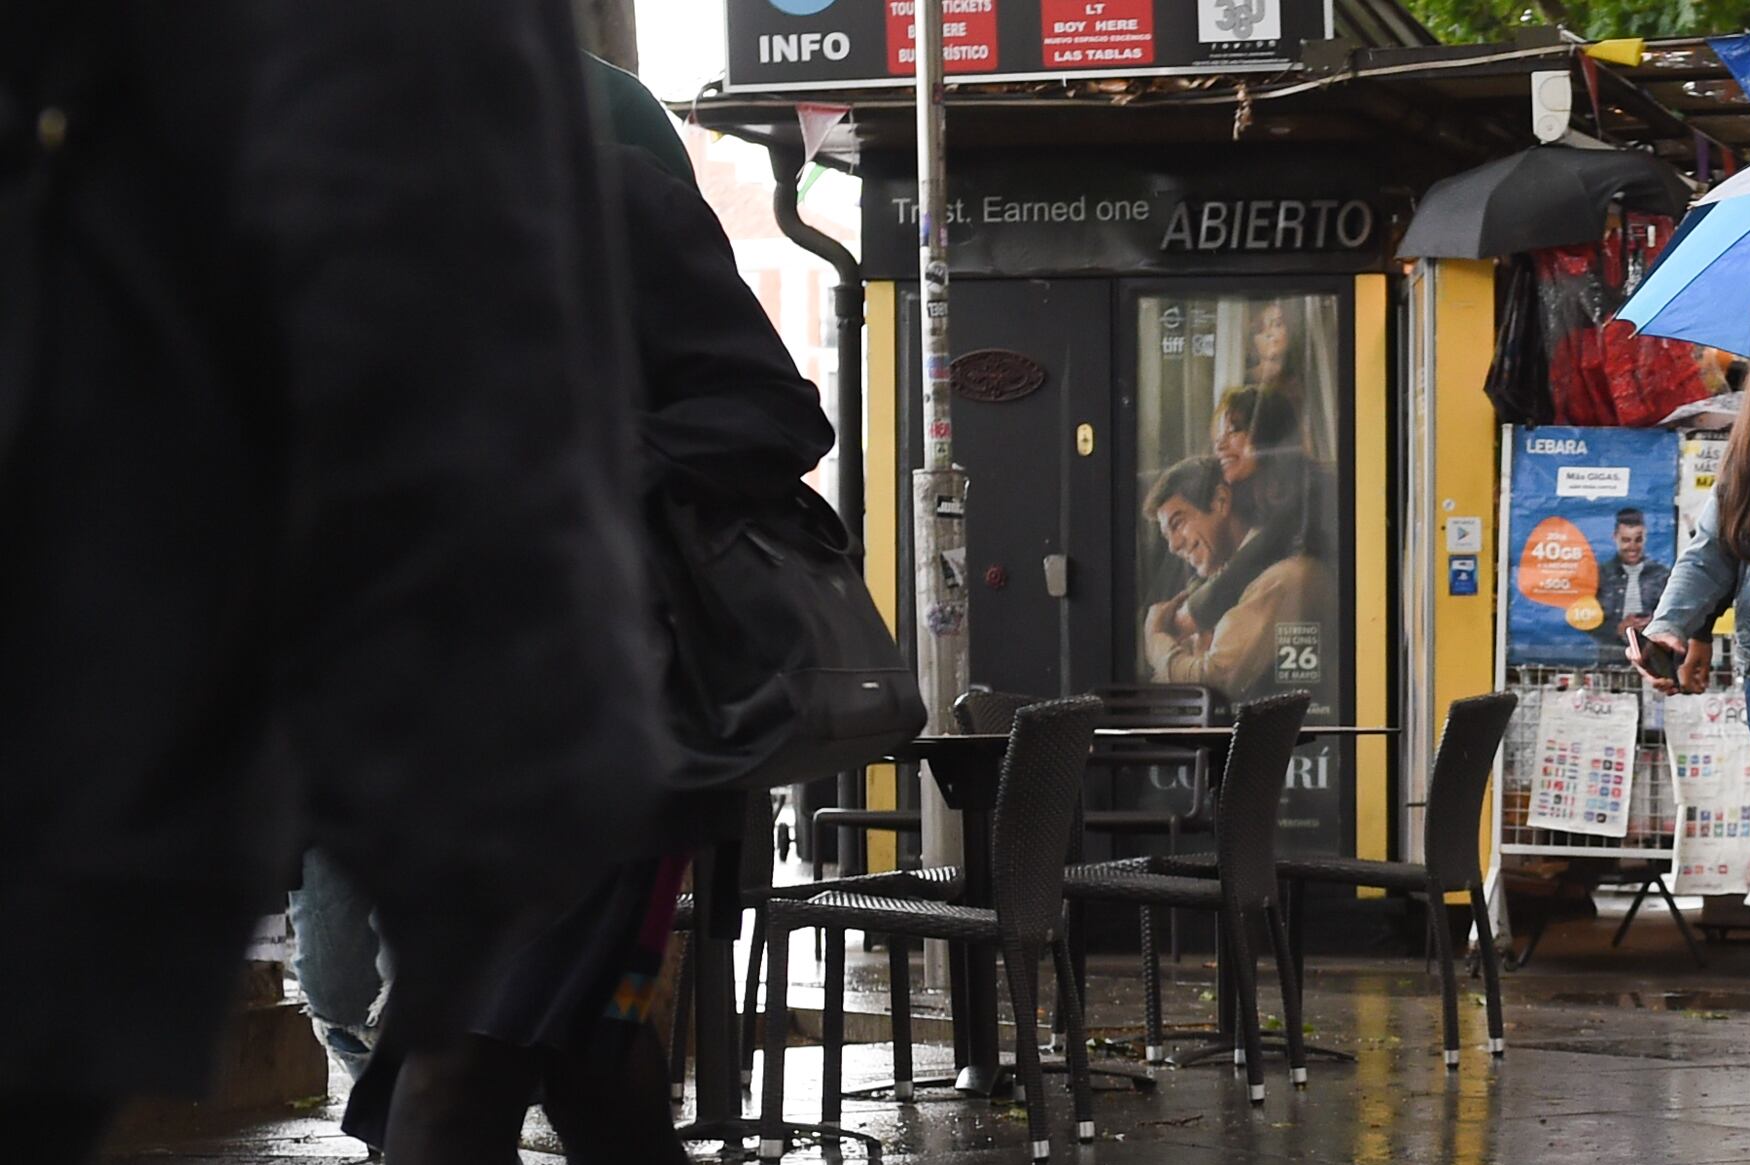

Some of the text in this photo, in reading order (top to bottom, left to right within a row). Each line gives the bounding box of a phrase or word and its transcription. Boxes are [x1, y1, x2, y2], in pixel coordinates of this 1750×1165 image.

[1095, 19, 1138, 31] HERE
[758, 32, 850, 63] INFO
[1054, 48, 1143, 62] LAS TABLAS
[892, 196, 1150, 224] Trst. Earned one
[1160, 200, 1372, 250] ABIERTO
[1526, 439, 1588, 454] LEBARA
[1279, 646, 1317, 670] 26
